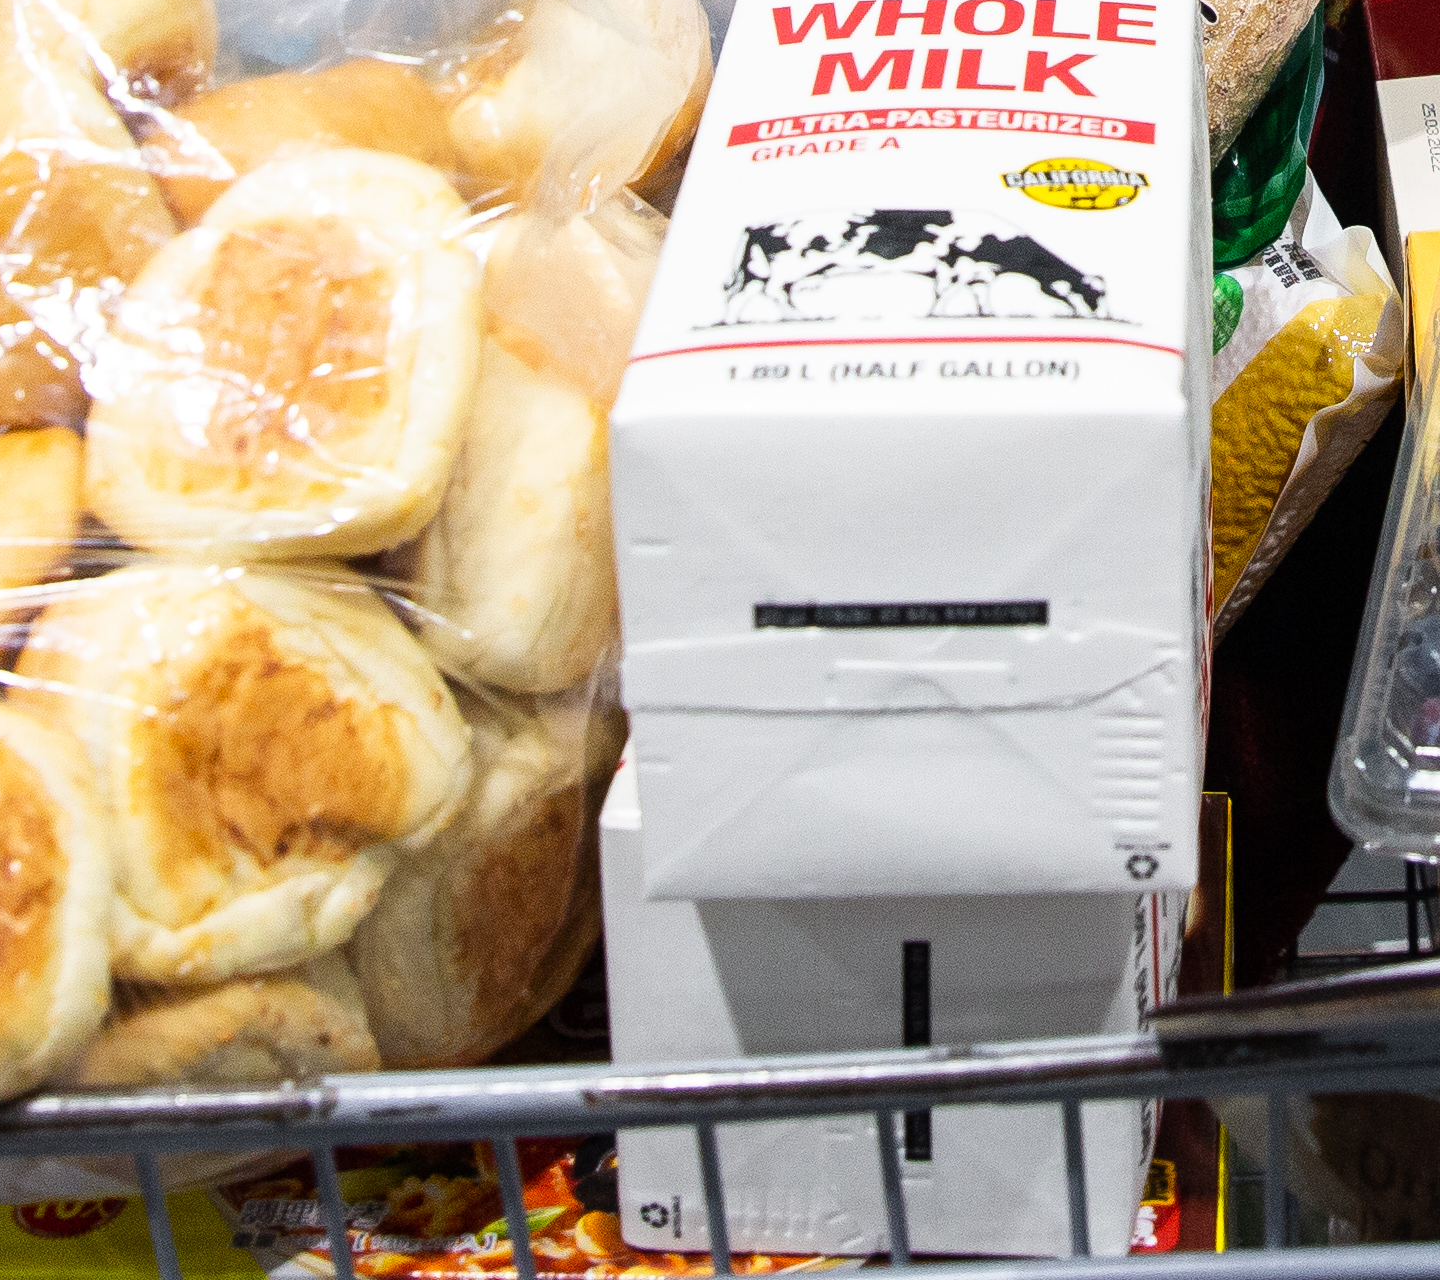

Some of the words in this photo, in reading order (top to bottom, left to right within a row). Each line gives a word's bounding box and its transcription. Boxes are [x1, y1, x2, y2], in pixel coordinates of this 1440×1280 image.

[811, 48, 1099, 99] MILK
[756, 109, 1128, 140] ULTRA-PASTEURIZED
[751, 137, 867, 163] GRADE
[878, 136, 901, 152] A
[1006, 169, 1147, 187] CALIFORNIA
[830, 360, 924, 382] (HALF
[938, 359, 1081, 382] GALLON)
